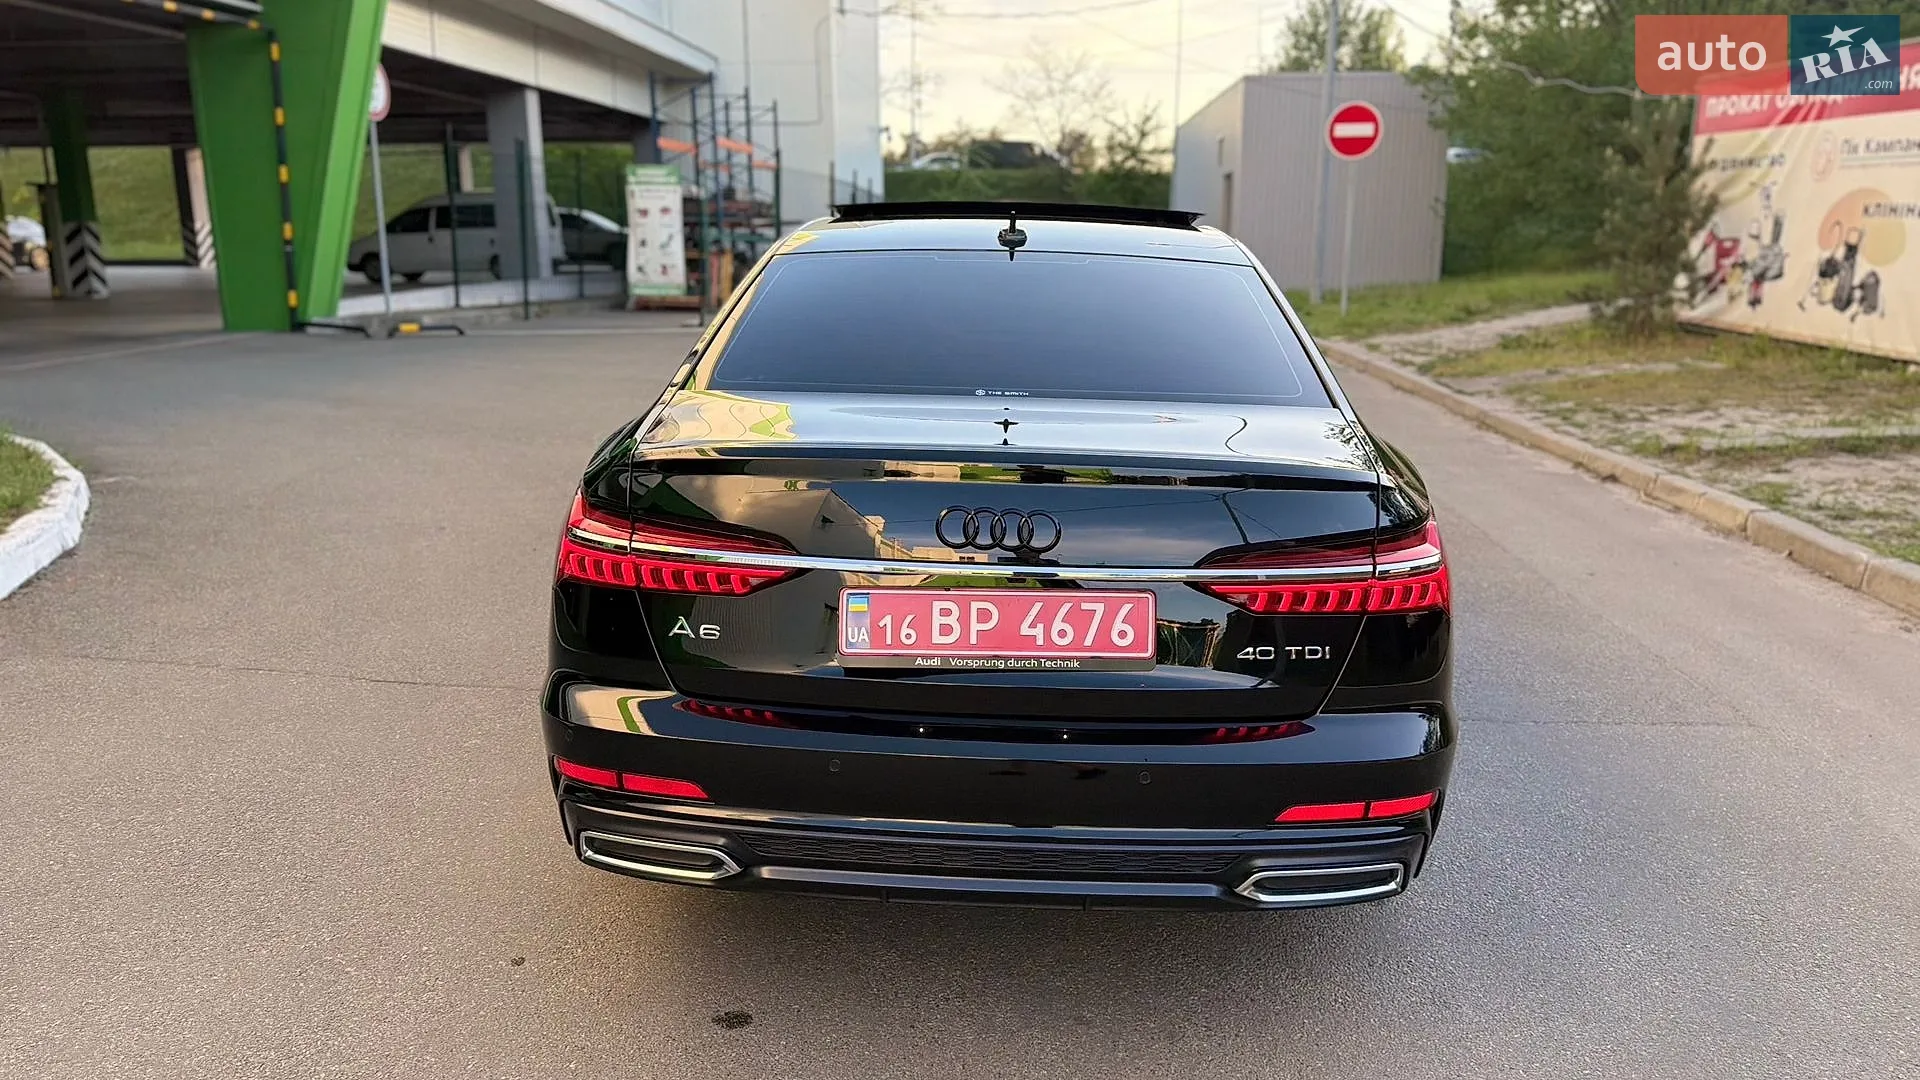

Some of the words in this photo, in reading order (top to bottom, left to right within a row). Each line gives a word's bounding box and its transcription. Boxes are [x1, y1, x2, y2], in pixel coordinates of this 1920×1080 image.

[668, 615, 721, 639] A6
[877, 614, 918, 646] 16
[931, 600, 1000, 646] BP
[1019, 602, 1136, 647] 4676
[847, 626, 870, 643] UA
[1237, 646, 1275, 660] 40
[1284, 646, 1331, 660] TDI
[914, 656, 942, 666] Audi
[949, 657, 1005, 669] Vorsprung
[1007, 658, 1038, 668] durch
[1039, 659, 1080, 668] Technik
